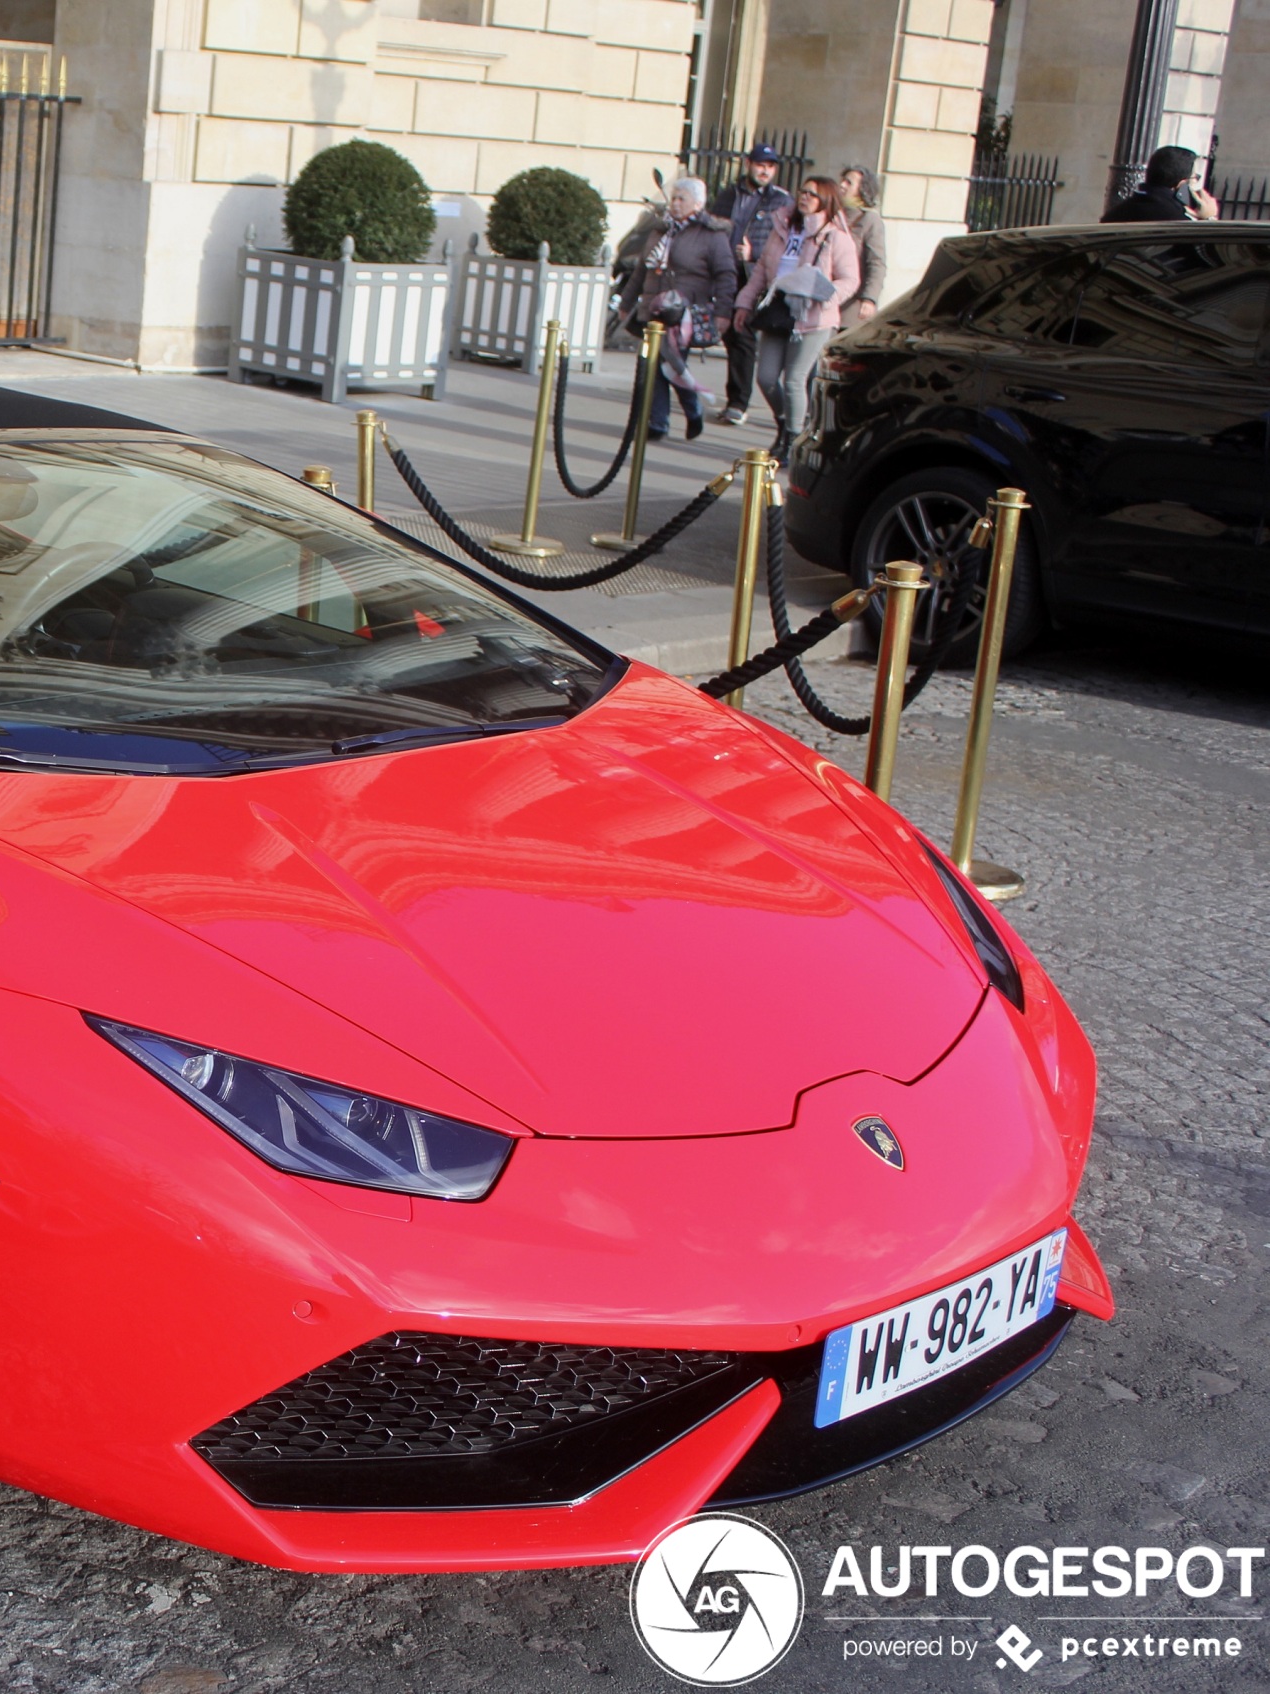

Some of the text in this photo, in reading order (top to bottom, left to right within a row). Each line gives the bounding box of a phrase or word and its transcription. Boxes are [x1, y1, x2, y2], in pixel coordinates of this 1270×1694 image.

[1040, 1270, 1059, 1304] 75
[856, 1249, 1042, 1394] WW-982-YA
[826, 1380, 837, 1401] F
